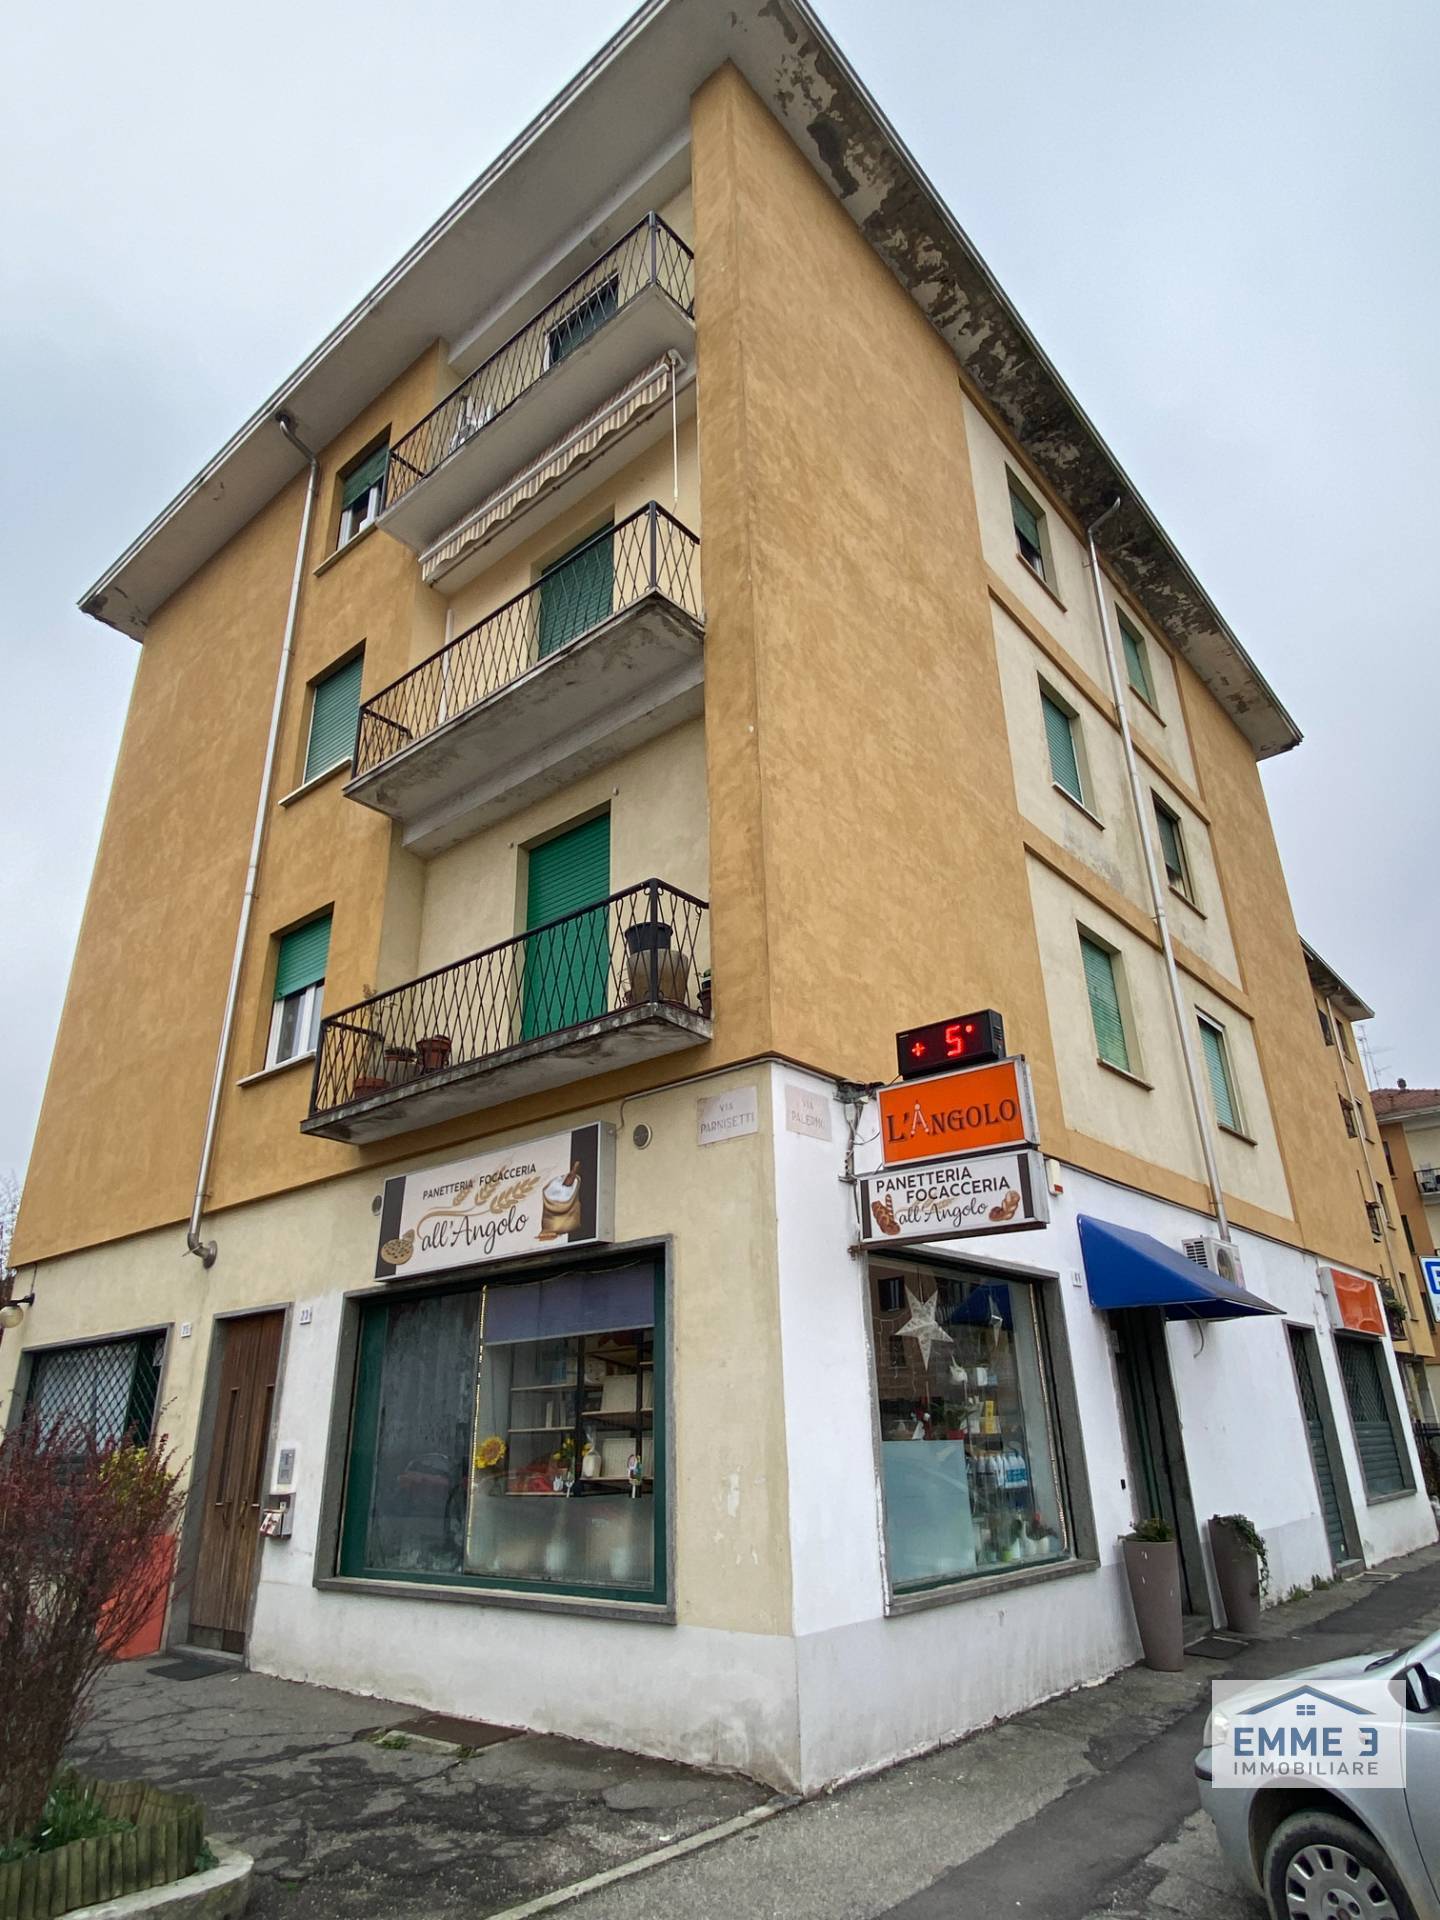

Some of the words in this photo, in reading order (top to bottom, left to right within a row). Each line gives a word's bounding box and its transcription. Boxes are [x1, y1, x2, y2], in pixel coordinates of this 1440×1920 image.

[719, 1102, 734, 1112] VIA
[886, 1099, 1017, 1142] L'ANGOLO
[700, 1113, 755, 1135] PARNISETTI
[422, 1178, 474, 1200] PANETTERIA
[479, 1163, 537, 1185] FOCACCERIA
[876, 1166, 972, 1193] PANETTERIA
[906, 1176, 1010, 1203] FOCACCERIA
[899, 1197, 988, 1228] all'Angolo
[421, 1205, 530, 1255] all'Angolo
